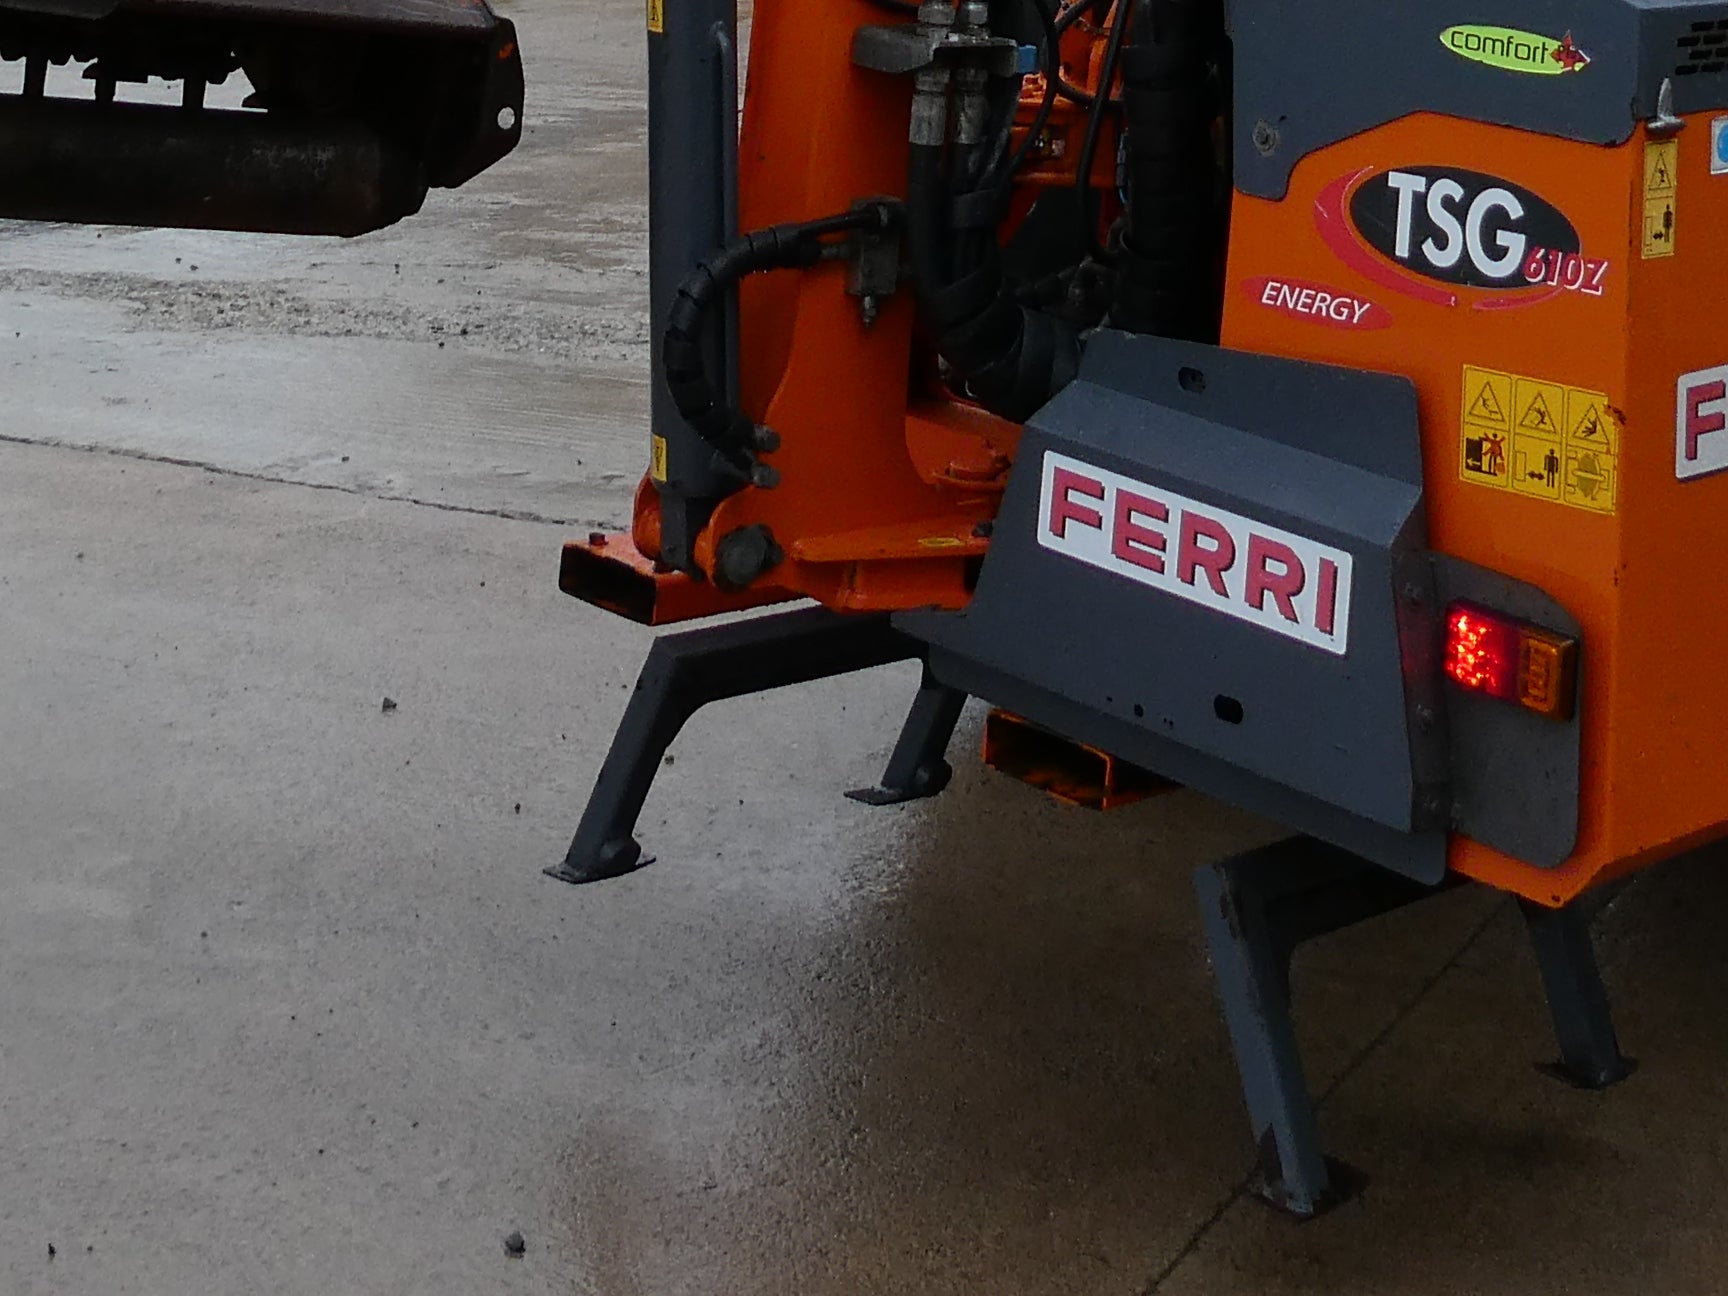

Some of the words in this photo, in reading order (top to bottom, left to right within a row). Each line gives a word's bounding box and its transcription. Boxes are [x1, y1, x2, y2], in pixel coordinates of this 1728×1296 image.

[1451, 30, 1549, 64] comfort
[1387, 171, 1526, 278] TSG
[1524, 247, 1609, 296] 610Z
[1261, 281, 1371, 325] ENERGY
[1048, 466, 1338, 636] FERRI
